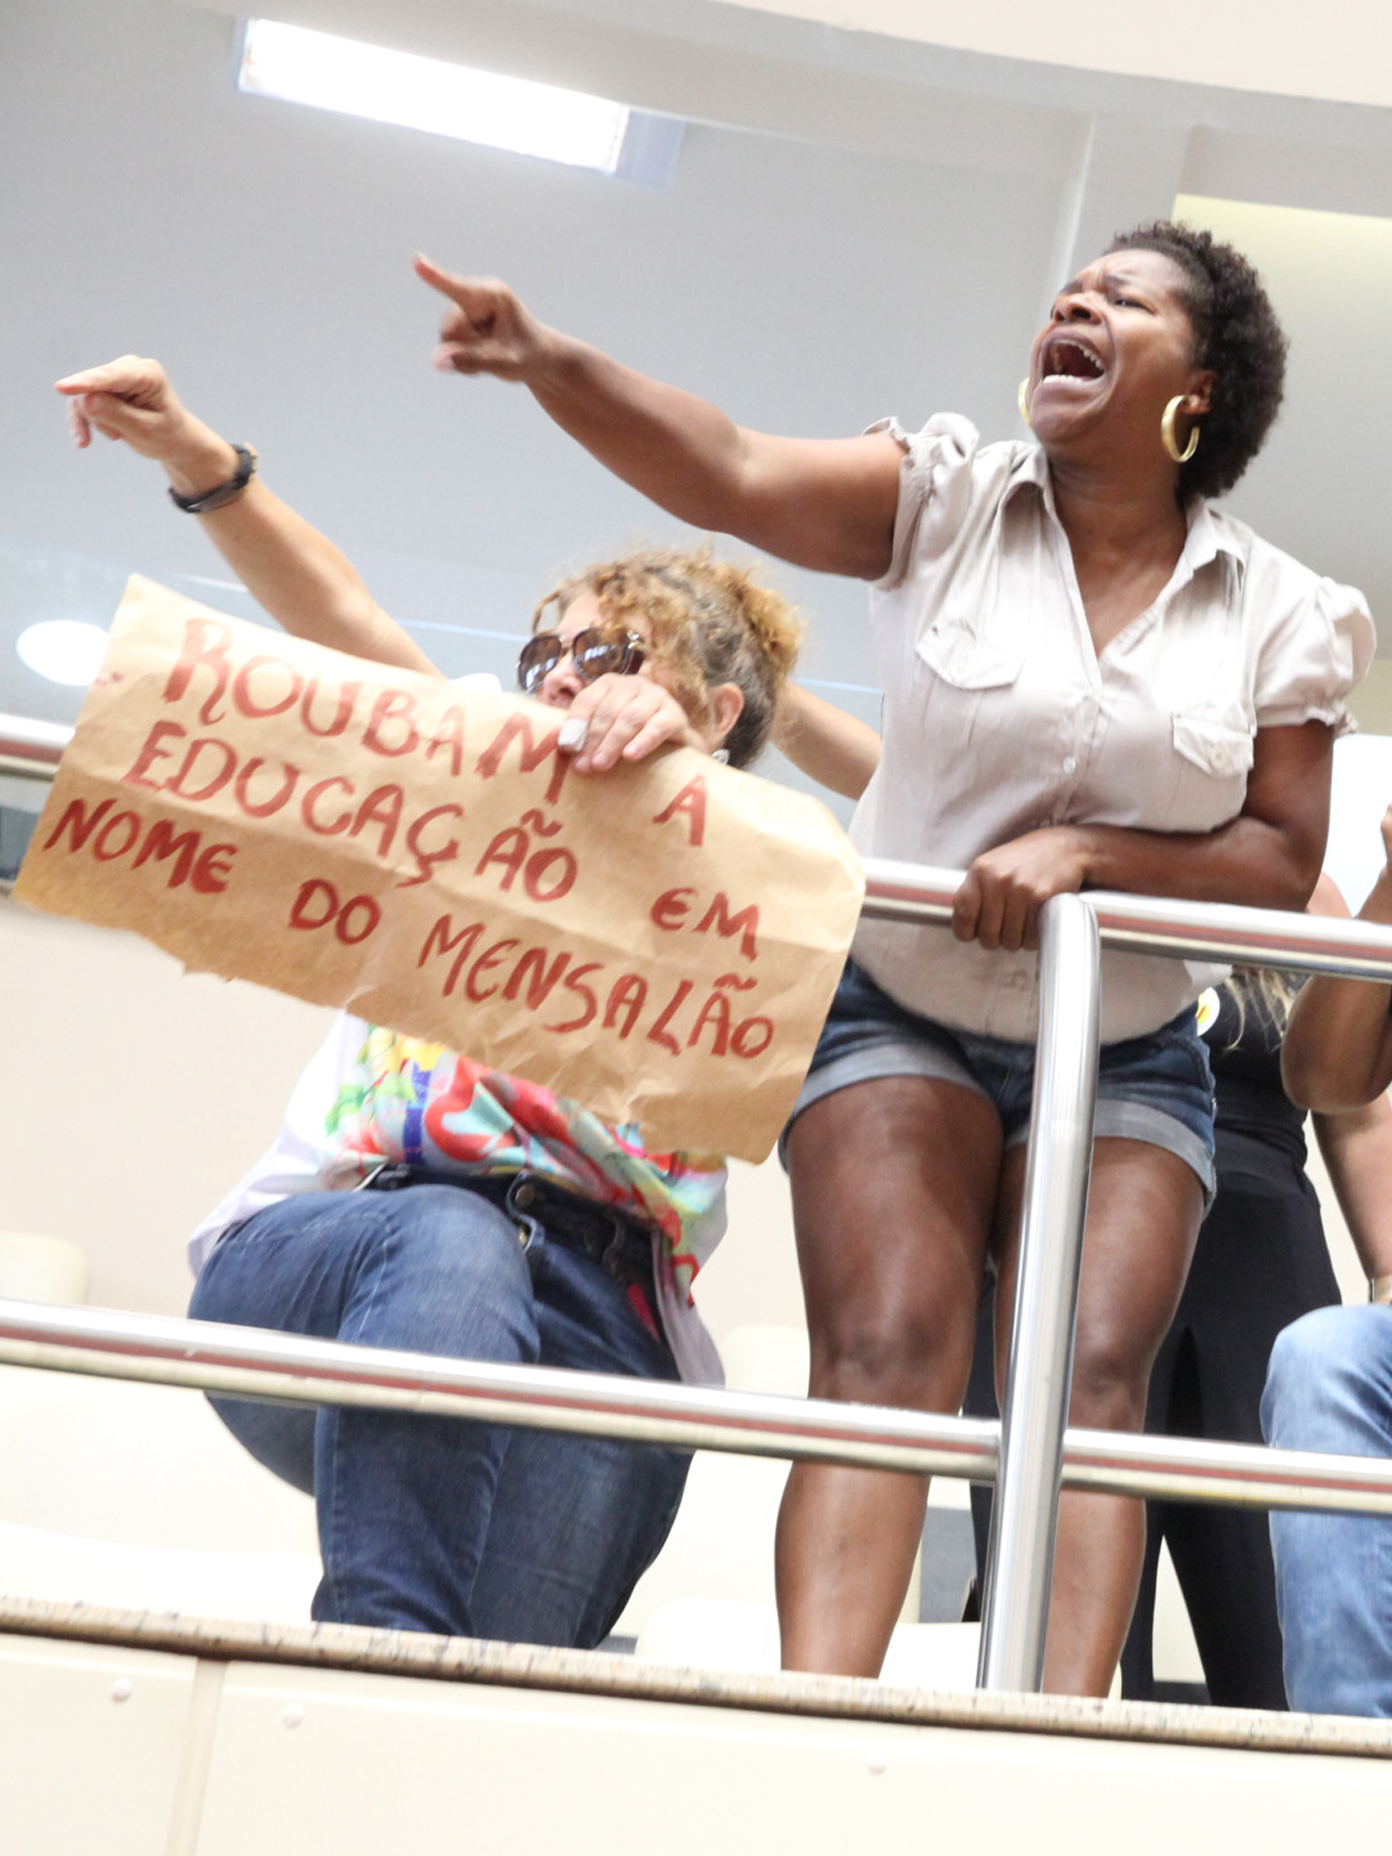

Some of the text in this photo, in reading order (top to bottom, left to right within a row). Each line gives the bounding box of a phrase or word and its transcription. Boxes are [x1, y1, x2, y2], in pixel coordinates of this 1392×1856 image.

[123, 721, 760, 962] EDUCAÇÃO EM
[162, 619, 708, 846] ROUBAM A
[44, 798, 776, 1058] NOME DO MENSALÃO
